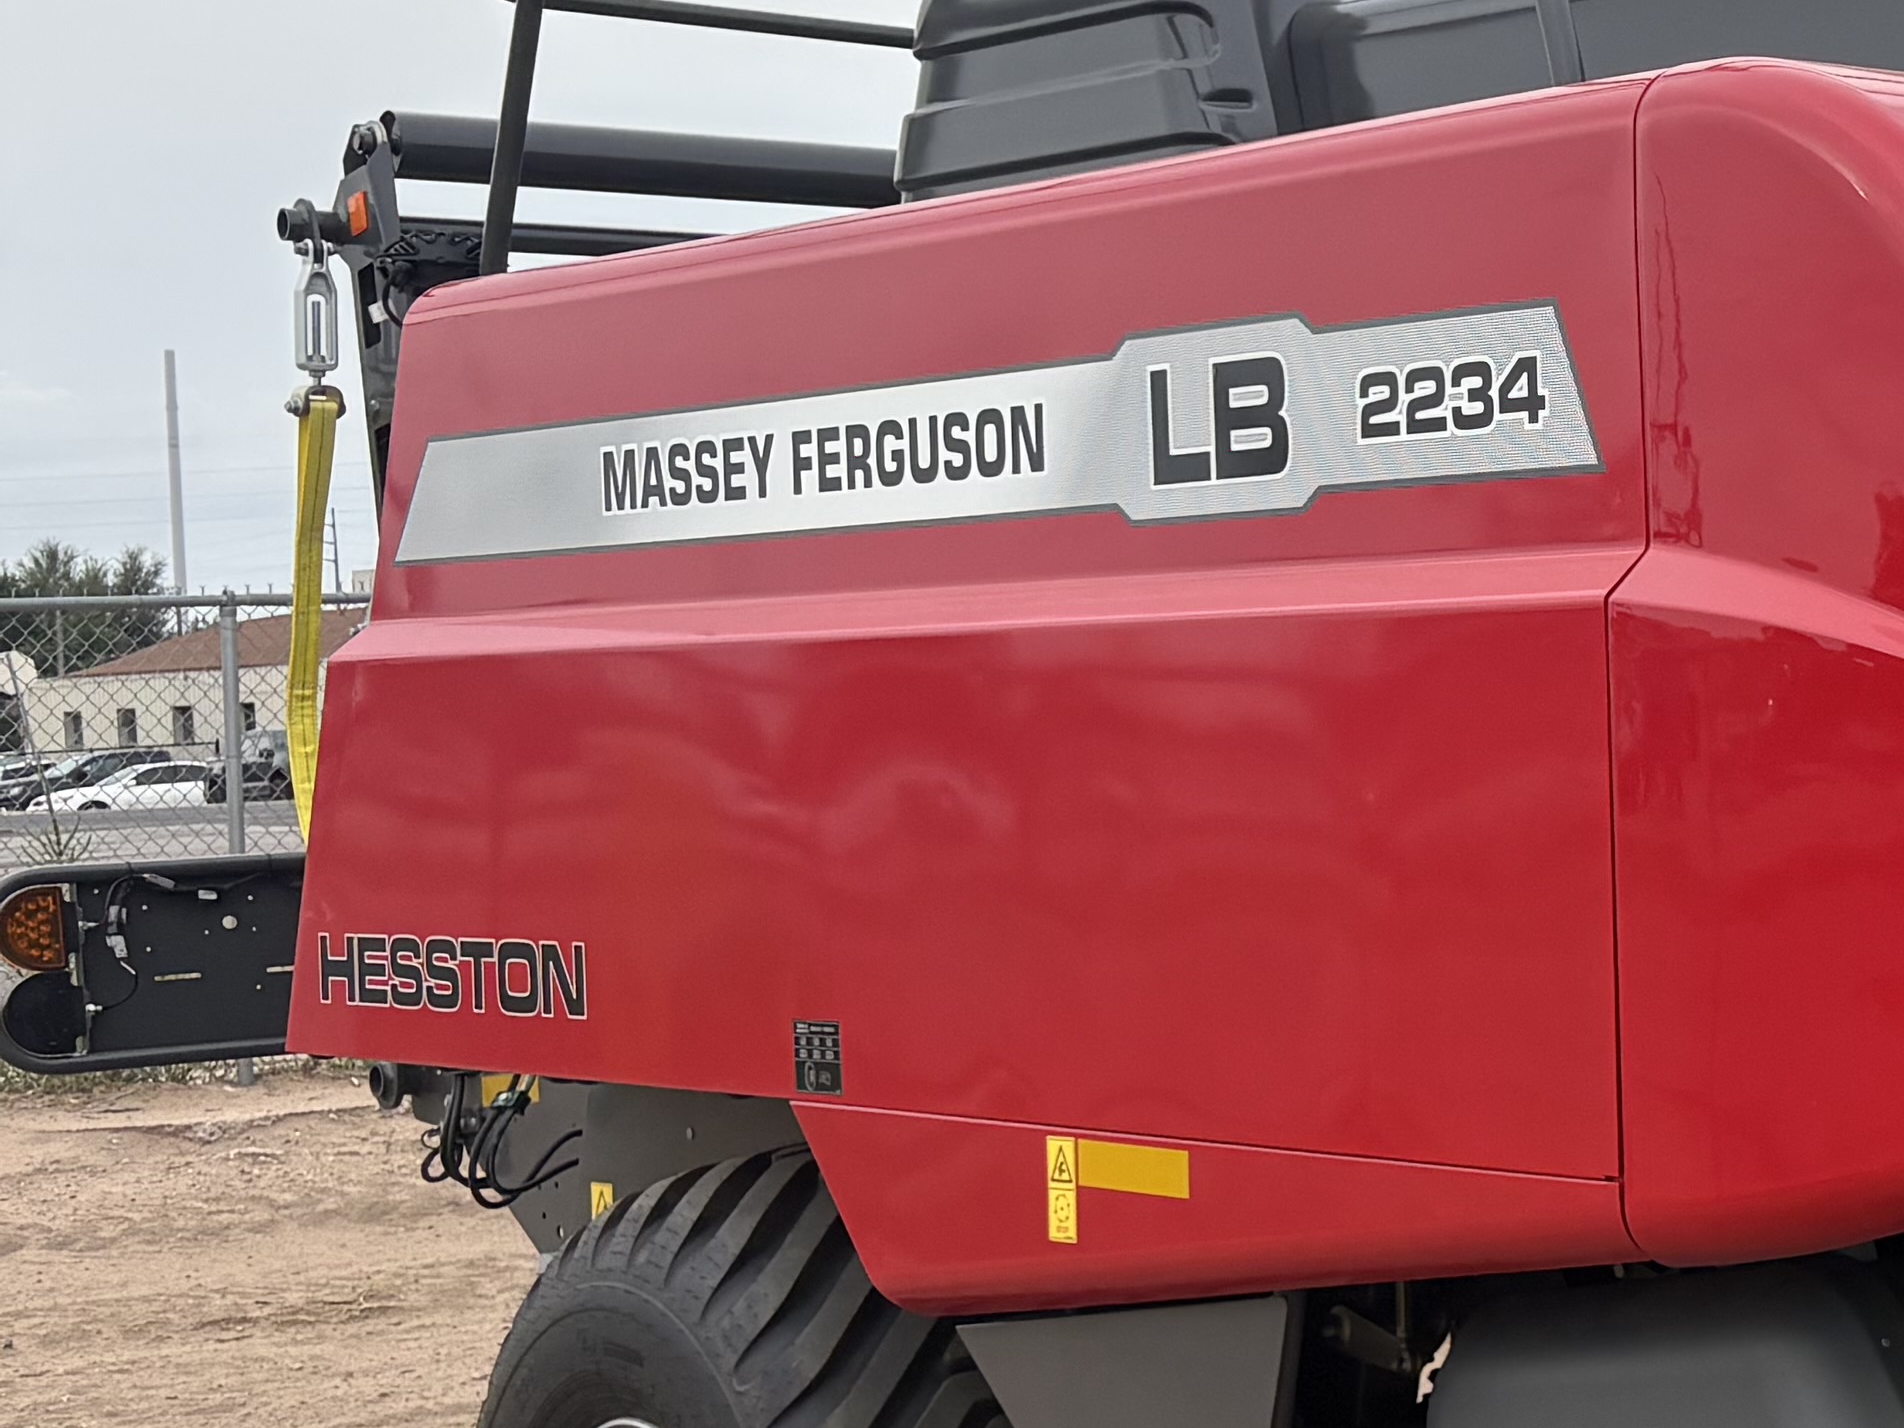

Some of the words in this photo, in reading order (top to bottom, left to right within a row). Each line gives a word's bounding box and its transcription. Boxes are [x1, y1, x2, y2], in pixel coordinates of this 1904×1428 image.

[602, 433, 775, 513] MASSEY
[791, 402, 1046, 496] FERGUSON
[1148, 354, 1291, 487] LB
[1357, 354, 1547, 441] 2234
[318, 932, 588, 1020] HESSTON
